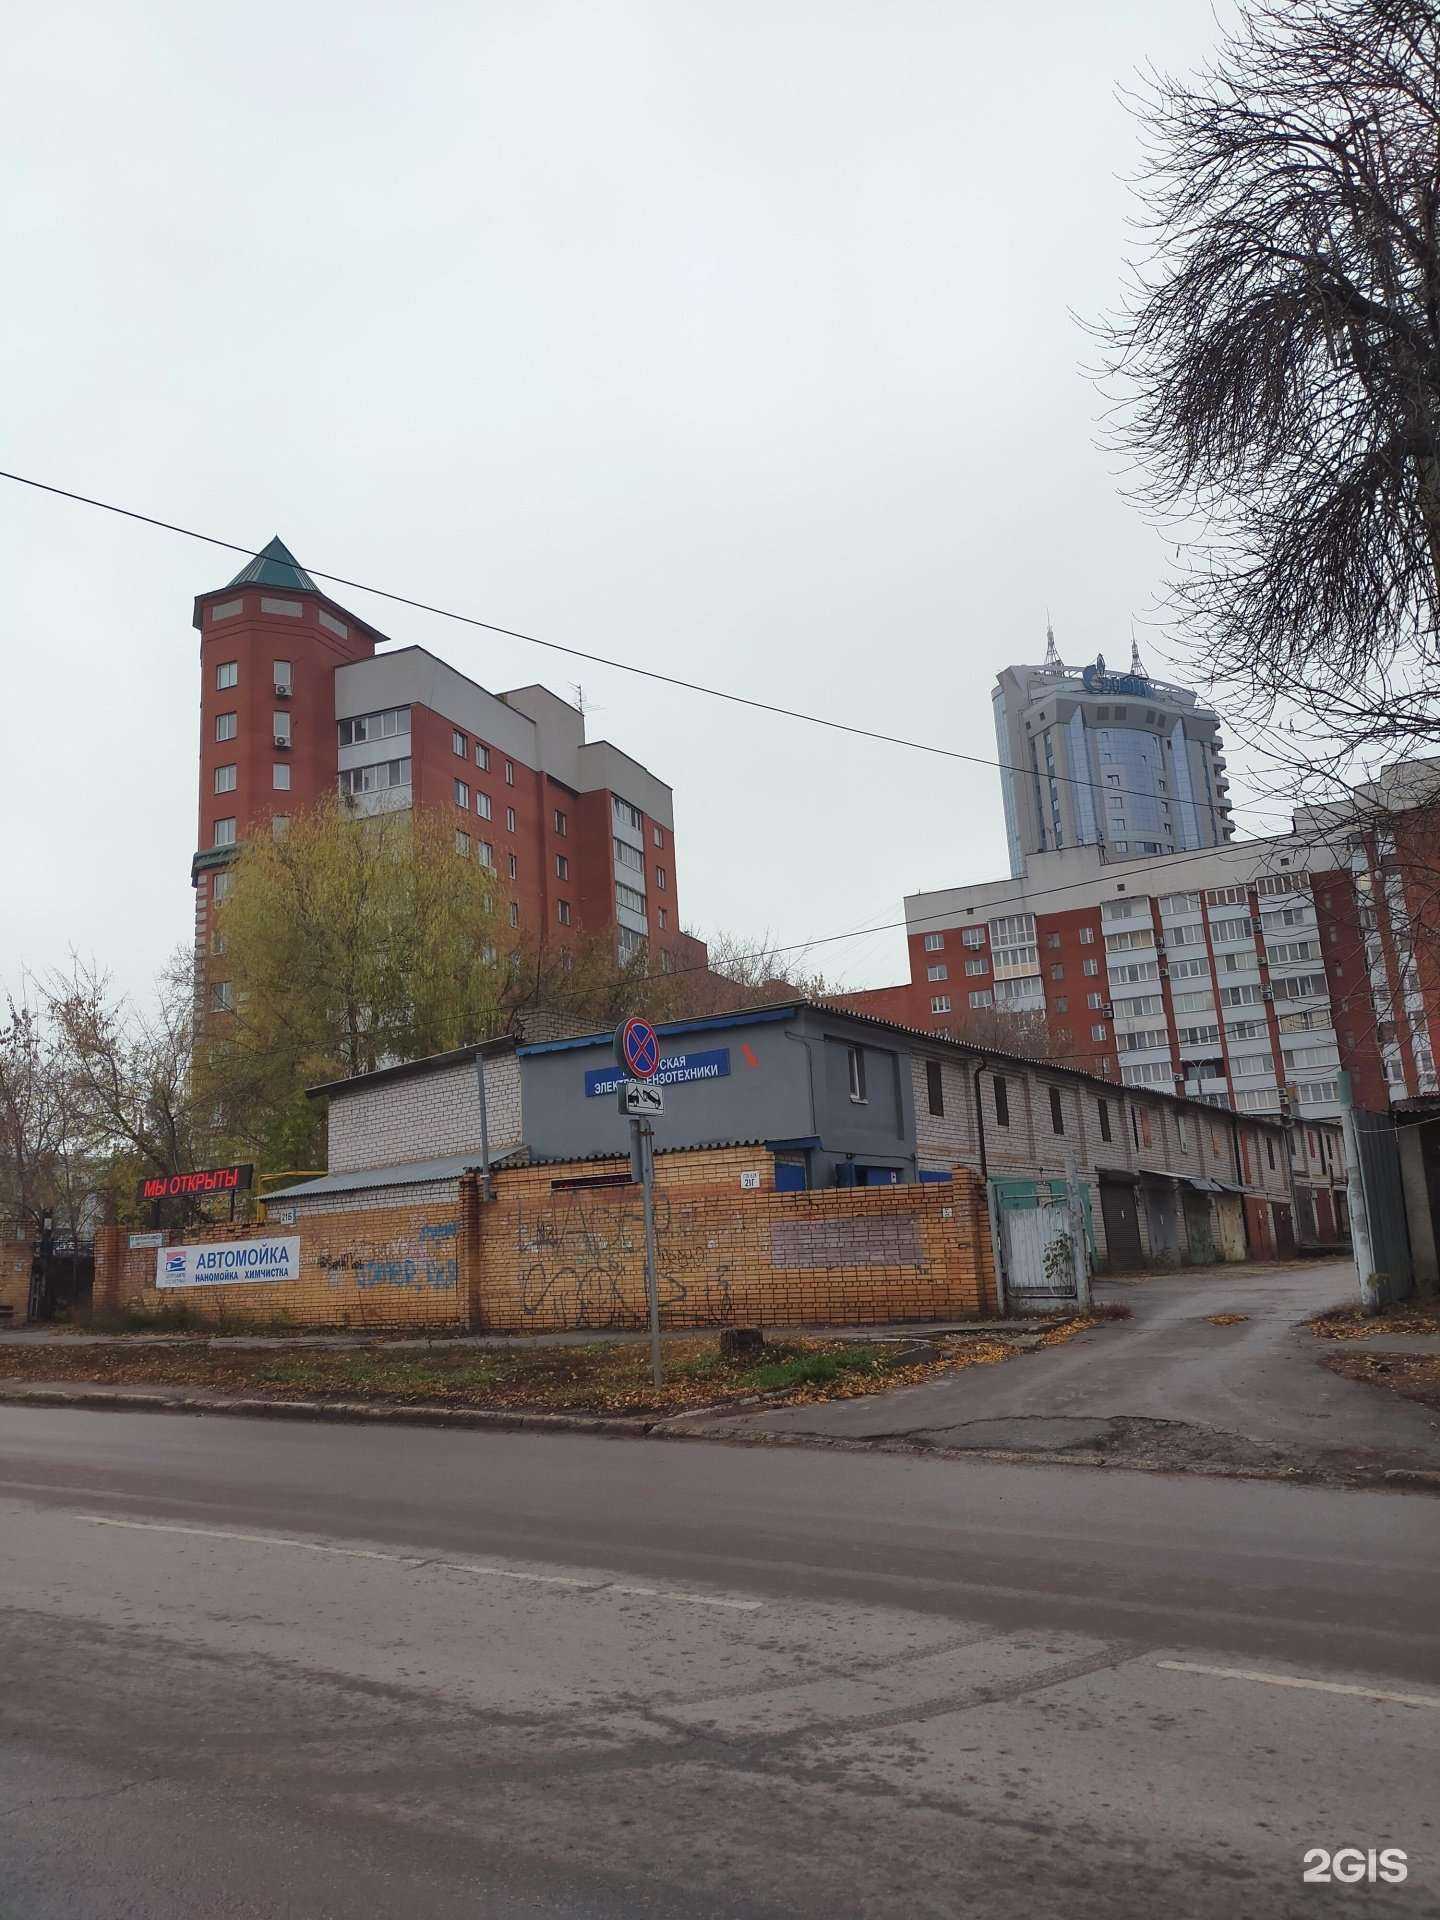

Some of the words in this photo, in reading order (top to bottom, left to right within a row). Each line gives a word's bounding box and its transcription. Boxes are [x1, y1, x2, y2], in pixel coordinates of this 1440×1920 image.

[143, 1178, 167, 1198] МЫ
[169, 1167, 239, 1195] ОТКРЫТЫ
[196, 1243, 289, 1269] АВТОМОЙКА
[195, 1269, 239, 1283] НАНОМОЙКА
[244, 1267, 289, 1280] ХИМЧИСТКА
